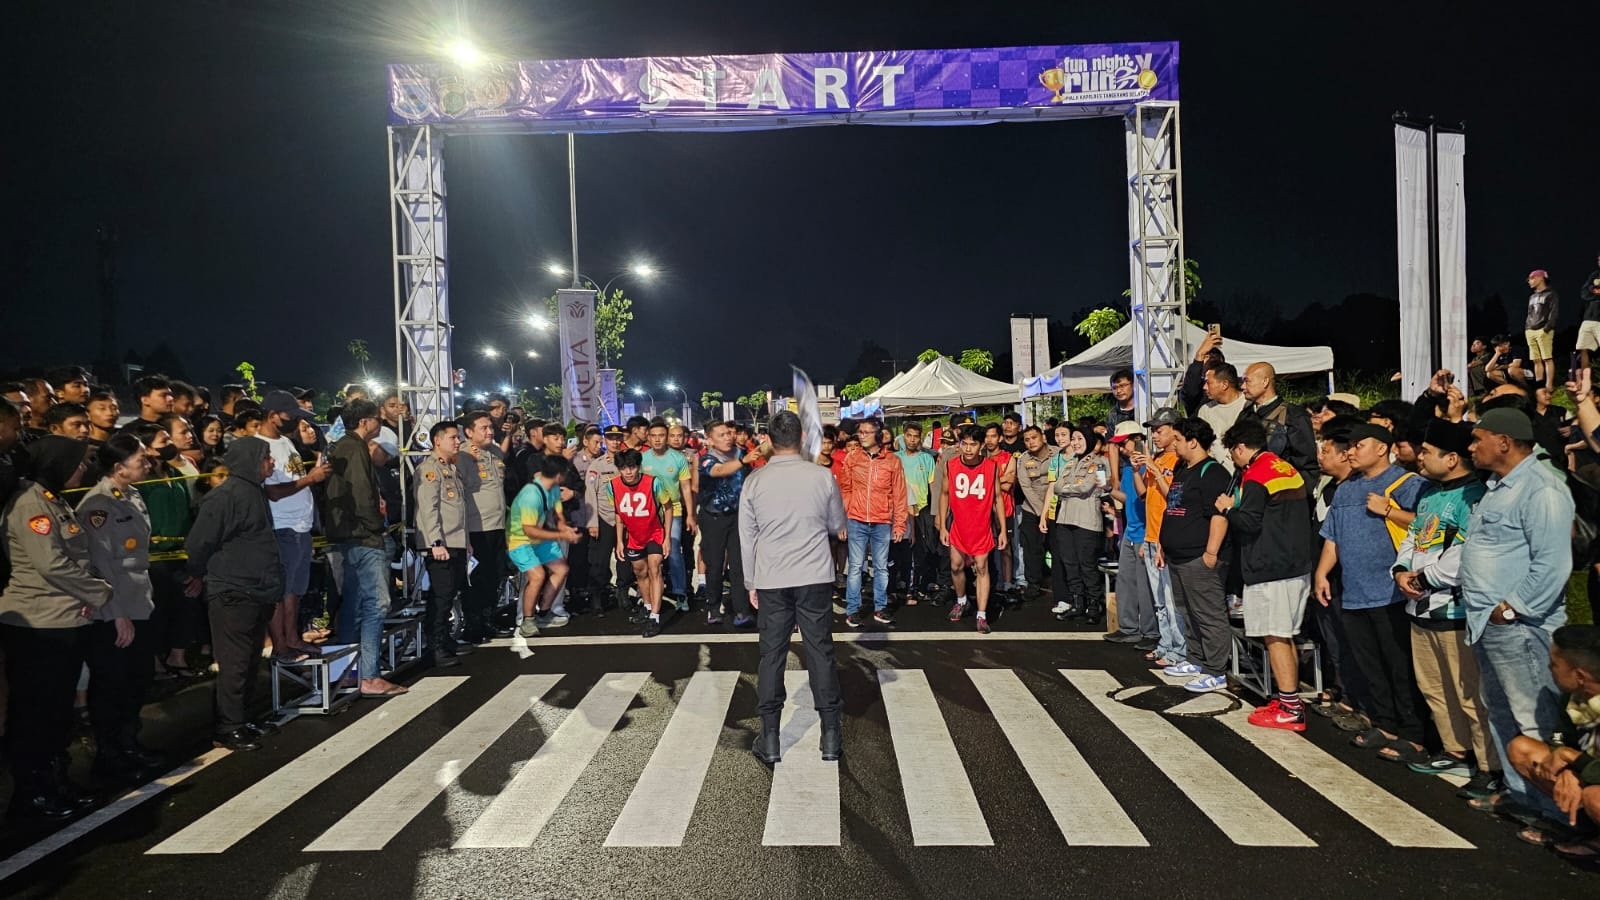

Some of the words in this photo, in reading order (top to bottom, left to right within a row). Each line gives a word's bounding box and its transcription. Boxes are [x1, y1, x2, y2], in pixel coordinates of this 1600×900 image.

[1064, 57, 1088, 73] fun
[1092, 54, 1130, 73] night
[638, 65, 905, 111] START
[1064, 70, 1117, 94] run
[955, 473, 986, 500] 94
[620, 492, 650, 517] 42
